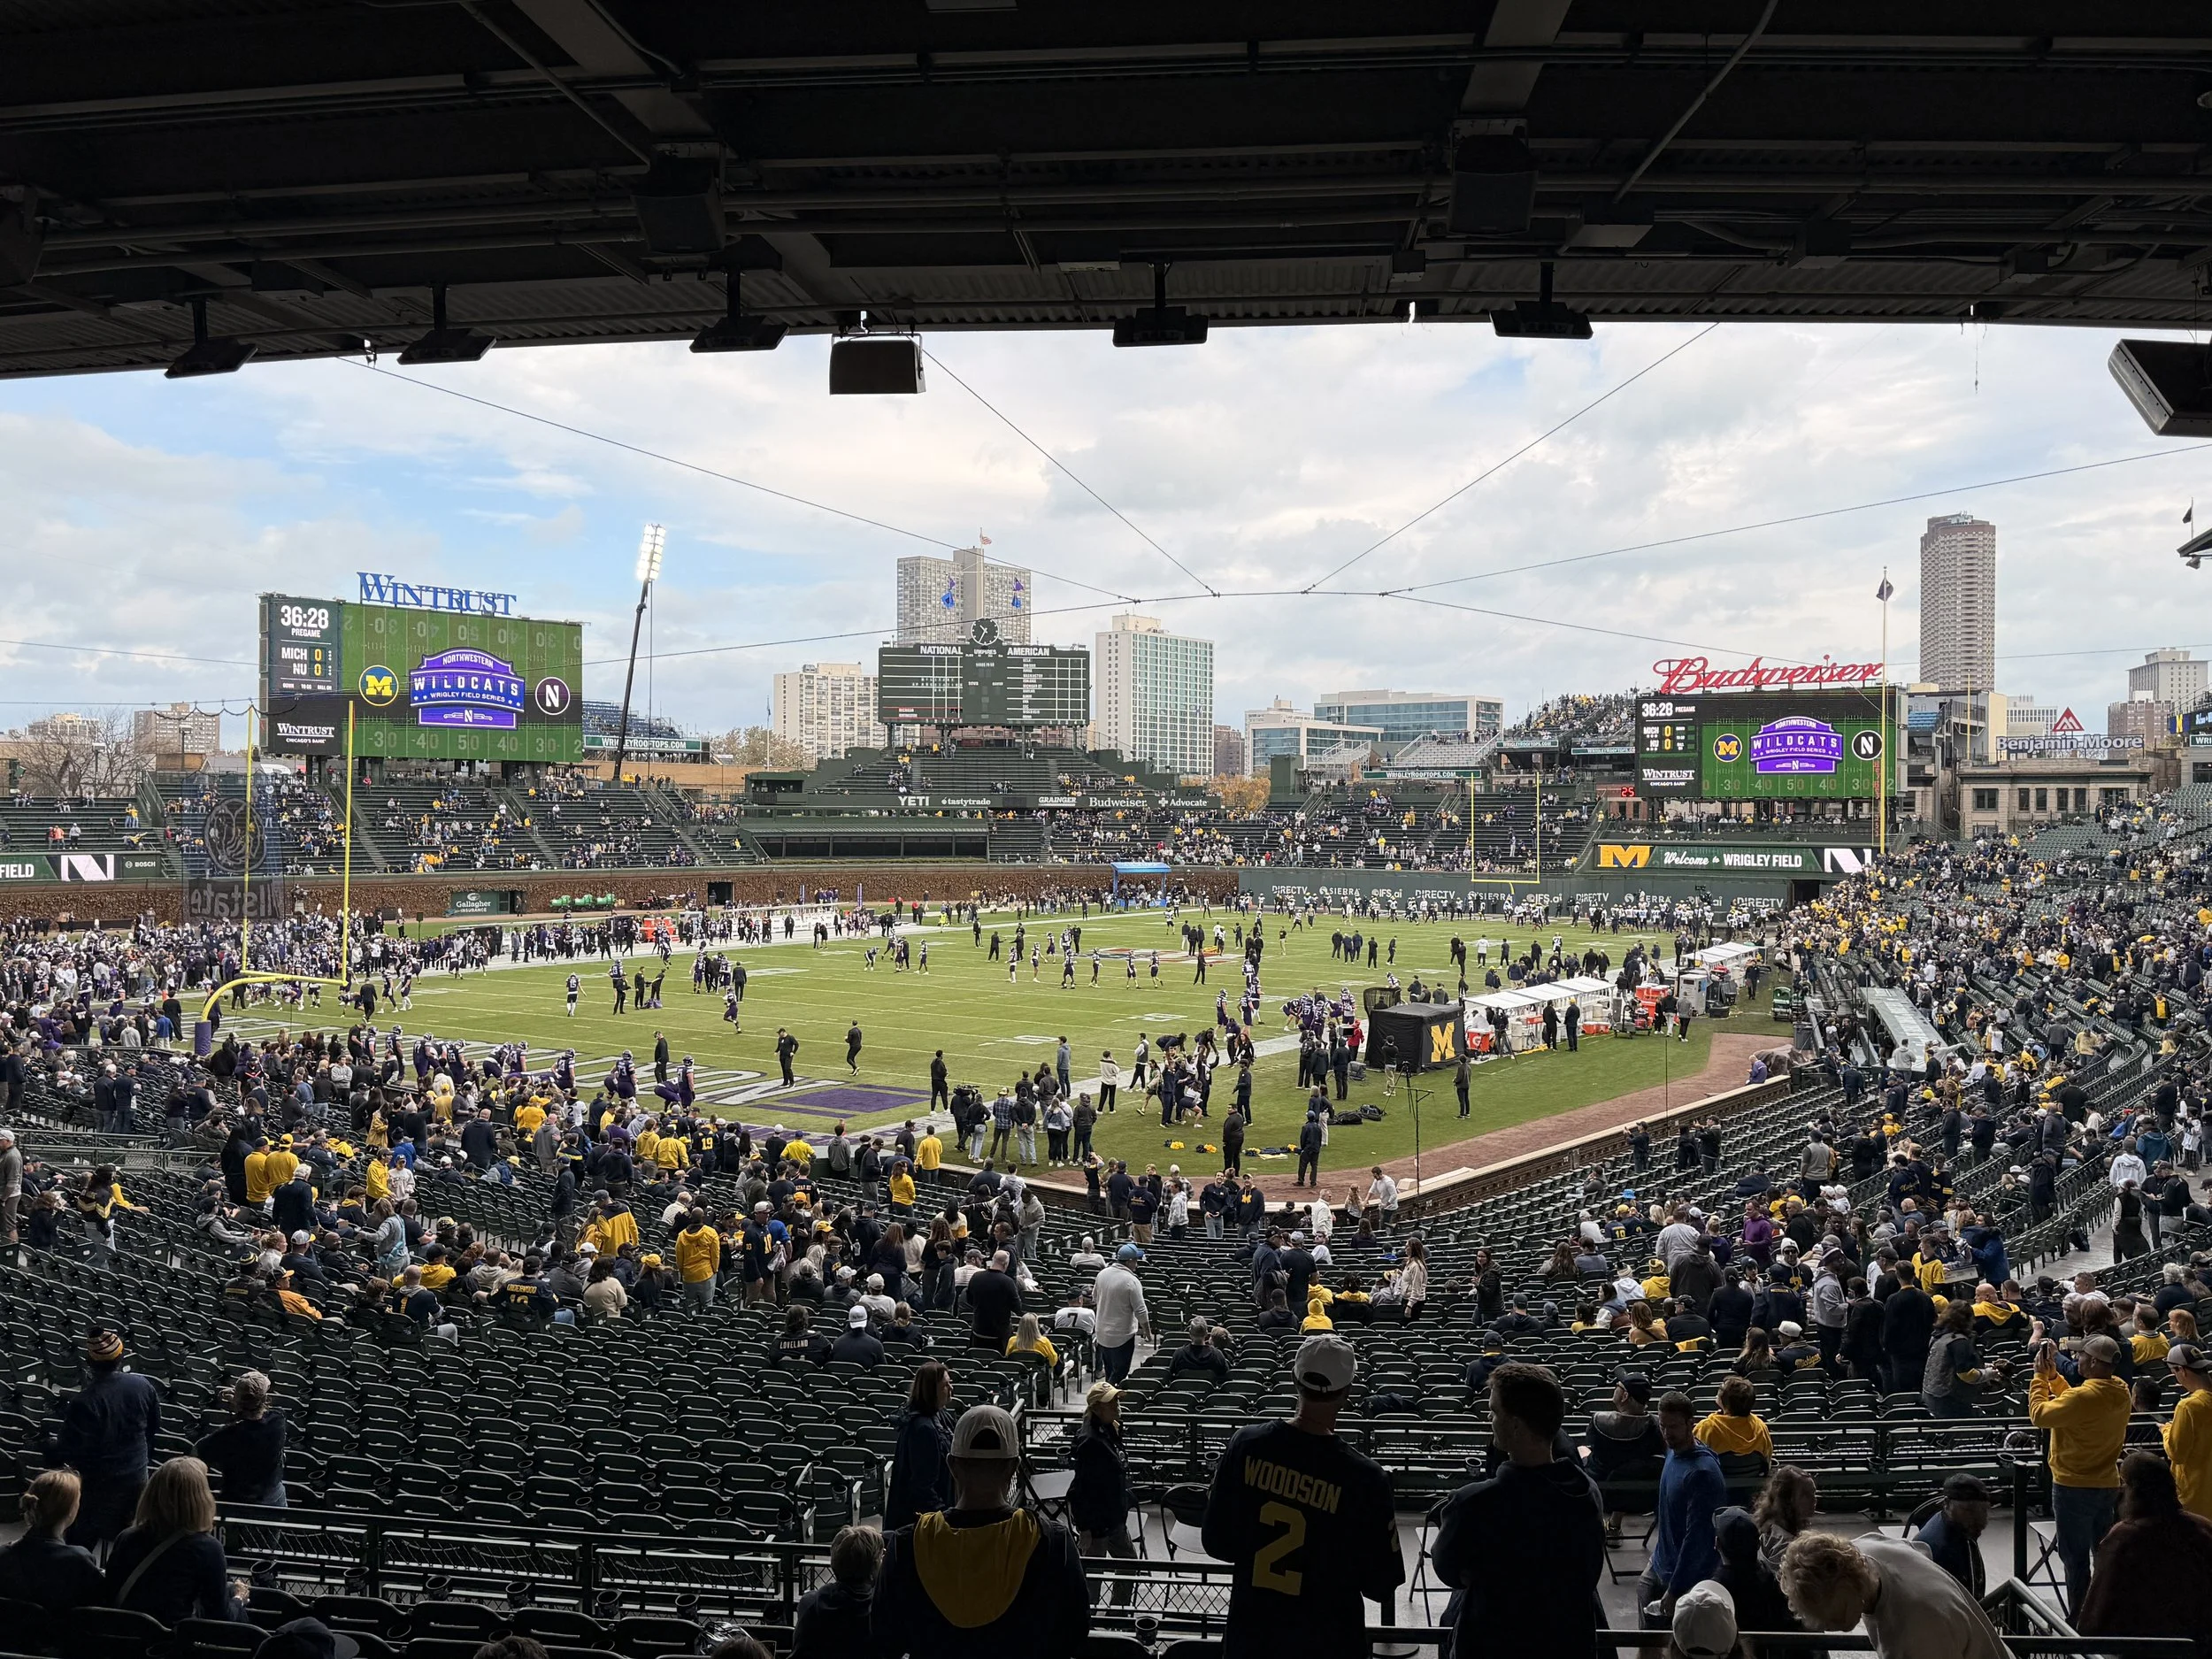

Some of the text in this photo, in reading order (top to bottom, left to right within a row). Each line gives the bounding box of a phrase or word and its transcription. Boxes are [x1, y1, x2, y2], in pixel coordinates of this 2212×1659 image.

[357, 572, 517, 616] WINTRUST
[280, 604, 329, 629] 36:28
[291, 627, 321, 638] PREGAME
[281, 647, 322, 662] MICH 0
[920, 645, 964, 655] NATIONAL
[1007, 647, 1050, 657] AMERICAN
[442, 653, 494, 669] NORTHWESTERN
[293, 663, 322, 676] NU 0
[1653, 655, 1884, 694] Budweiser
[365, 674, 393, 696] M
[413, 674, 518, 695] WILDCATS
[481, 693, 505, 703] SERIES
[545, 684, 559, 707] N
[464, 709, 473, 723] N
[1641, 702, 1673, 717] 36:28
[277, 722, 335, 735] WINTRUST
[1775, 718, 1816, 730] NORTHWESTERN
[1664, 726, 1671, 737] 0
[1664, 739, 1671, 750] 0
[1717, 741, 1738, 756] M
[1753, 735, 1838, 749] WILDCATS
[1861, 736, 1873, 755] N
[1996, 734, 2145, 754] Benjamin Moore
[1792, 760, 1799, 770] N
[1642, 768, 1695, 779] WINTRUST
[1621, 787, 1635, 796] 25
[898, 796, 929, 806] YETI
[946, 797, 991, 807] tastytrade
[1170, 798, 1208, 807] Advocate
[1597, 844, 1655, 868] M
[1663, 851, 1709, 866] Welcome
[1723, 853, 1770, 867] WRIGLEY
[1772, 855, 1802, 868] FIELD
[1824, 848, 1871, 873] N
[60, 854, 115, 882] N
[1271, 885, 1308, 895] DIRECTV
[1329, 887, 1360, 895] SIERRA
[1416, 889, 1455, 899] DIRECTV
[1737, 897, 1784, 908] DIRECTV
[1430, 1021, 1455, 1063] M
[567, 1106, 574, 1117] 2
[701, 1137, 713, 1150] 19
[1067, 1312, 1079, 1327] 7
[780, 1339, 809, 1349] LOVELAND
[1794, 1352, 1822, 1371] Michigan
[1243, 1455, 1342, 1515] WOODSON
[1251, 1500, 1307, 1596] 2
